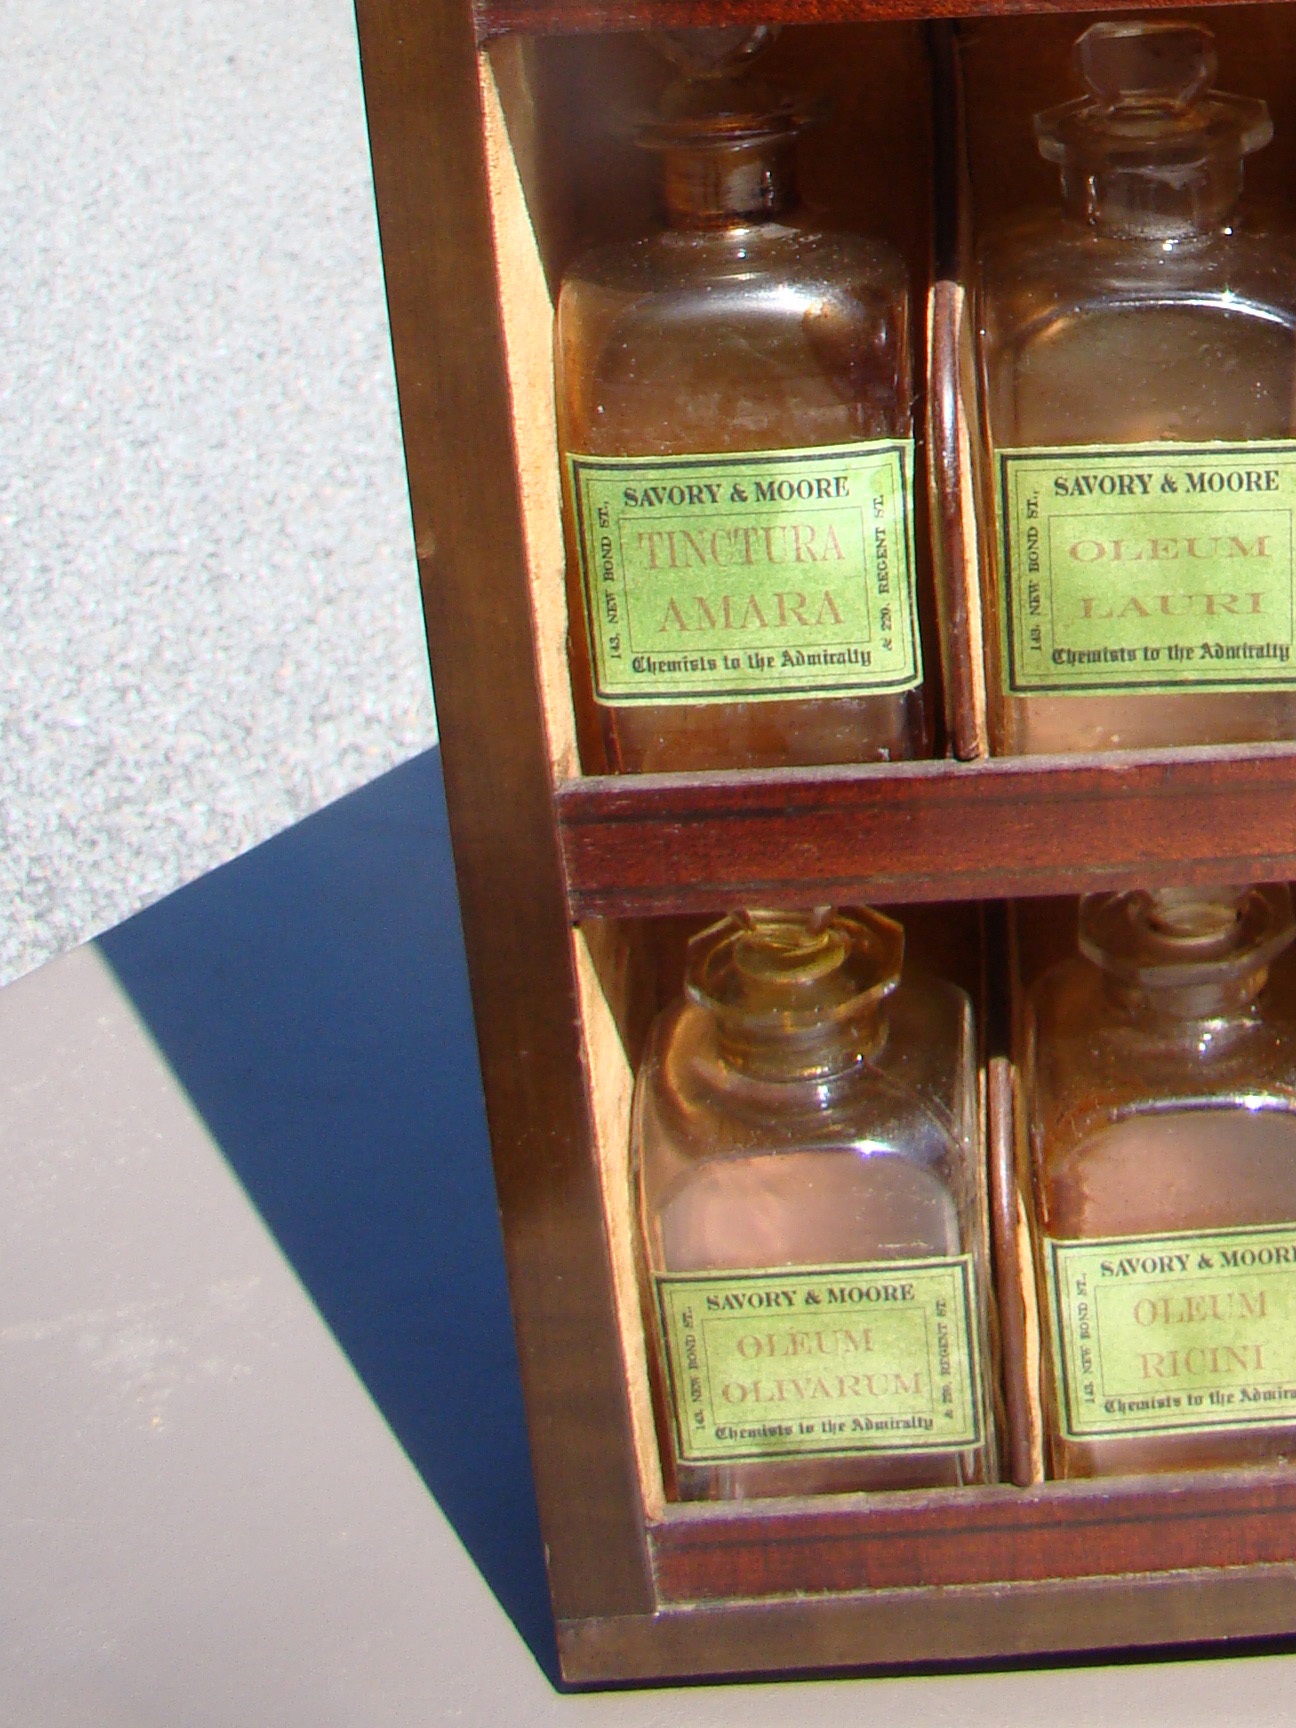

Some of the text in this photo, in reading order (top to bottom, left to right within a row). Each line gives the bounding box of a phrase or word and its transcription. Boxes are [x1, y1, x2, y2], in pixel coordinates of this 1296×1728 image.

[624, 476, 849, 508] SAVORY & MOORE
[1054, 470, 1279, 496] SAVORY & MOORE
[874, 494, 885, 519] ST.
[602, 535, 615, 581] BOND
[638, 524, 844, 570] TINCTURA
[874, 526, 889, 594] REGENT
[1028, 526, 1040, 573] BOND
[1069, 536, 1272, 562] OLEUM
[607, 594, 618, 623] NEW
[659, 590, 844, 632] AMARA
[1029, 579, 1041, 616] NEW
[1081, 592, 1267, 619] LAURI
[882, 639, 893, 651] &
[1052, 642, 1290, 666] Chemists to the Admiralty
[632, 648, 871, 676] Chemists to the Admiralty
[1100, 1254, 1190, 1277] SAVORY
[1198, 1253, 1213, 1269] &
[706, 1283, 914, 1311] SAVORY & MOORE
[1133, 1290, 1268, 1326] OLEUM
[1079, 1302, 1091, 1340] BOND
[686, 1333, 698, 1370] BOND
[737, 1327, 873, 1359] OLEUM
[937, 1321, 950, 1375] REGENT
[1081, 1345, 1092, 1373] NEW
[1137, 1343, 1266, 1380] RICINI
[691, 1376, 701, 1402] NEW
[722, 1372, 921, 1404] OLIVARUM
[1104, 1396, 1181, 1416] Chemists
[1187, 1393, 1203, 1407] to
[1209, 1390, 1234, 1407] the
[715, 1415, 933, 1441] Chemists to the Admiralty
